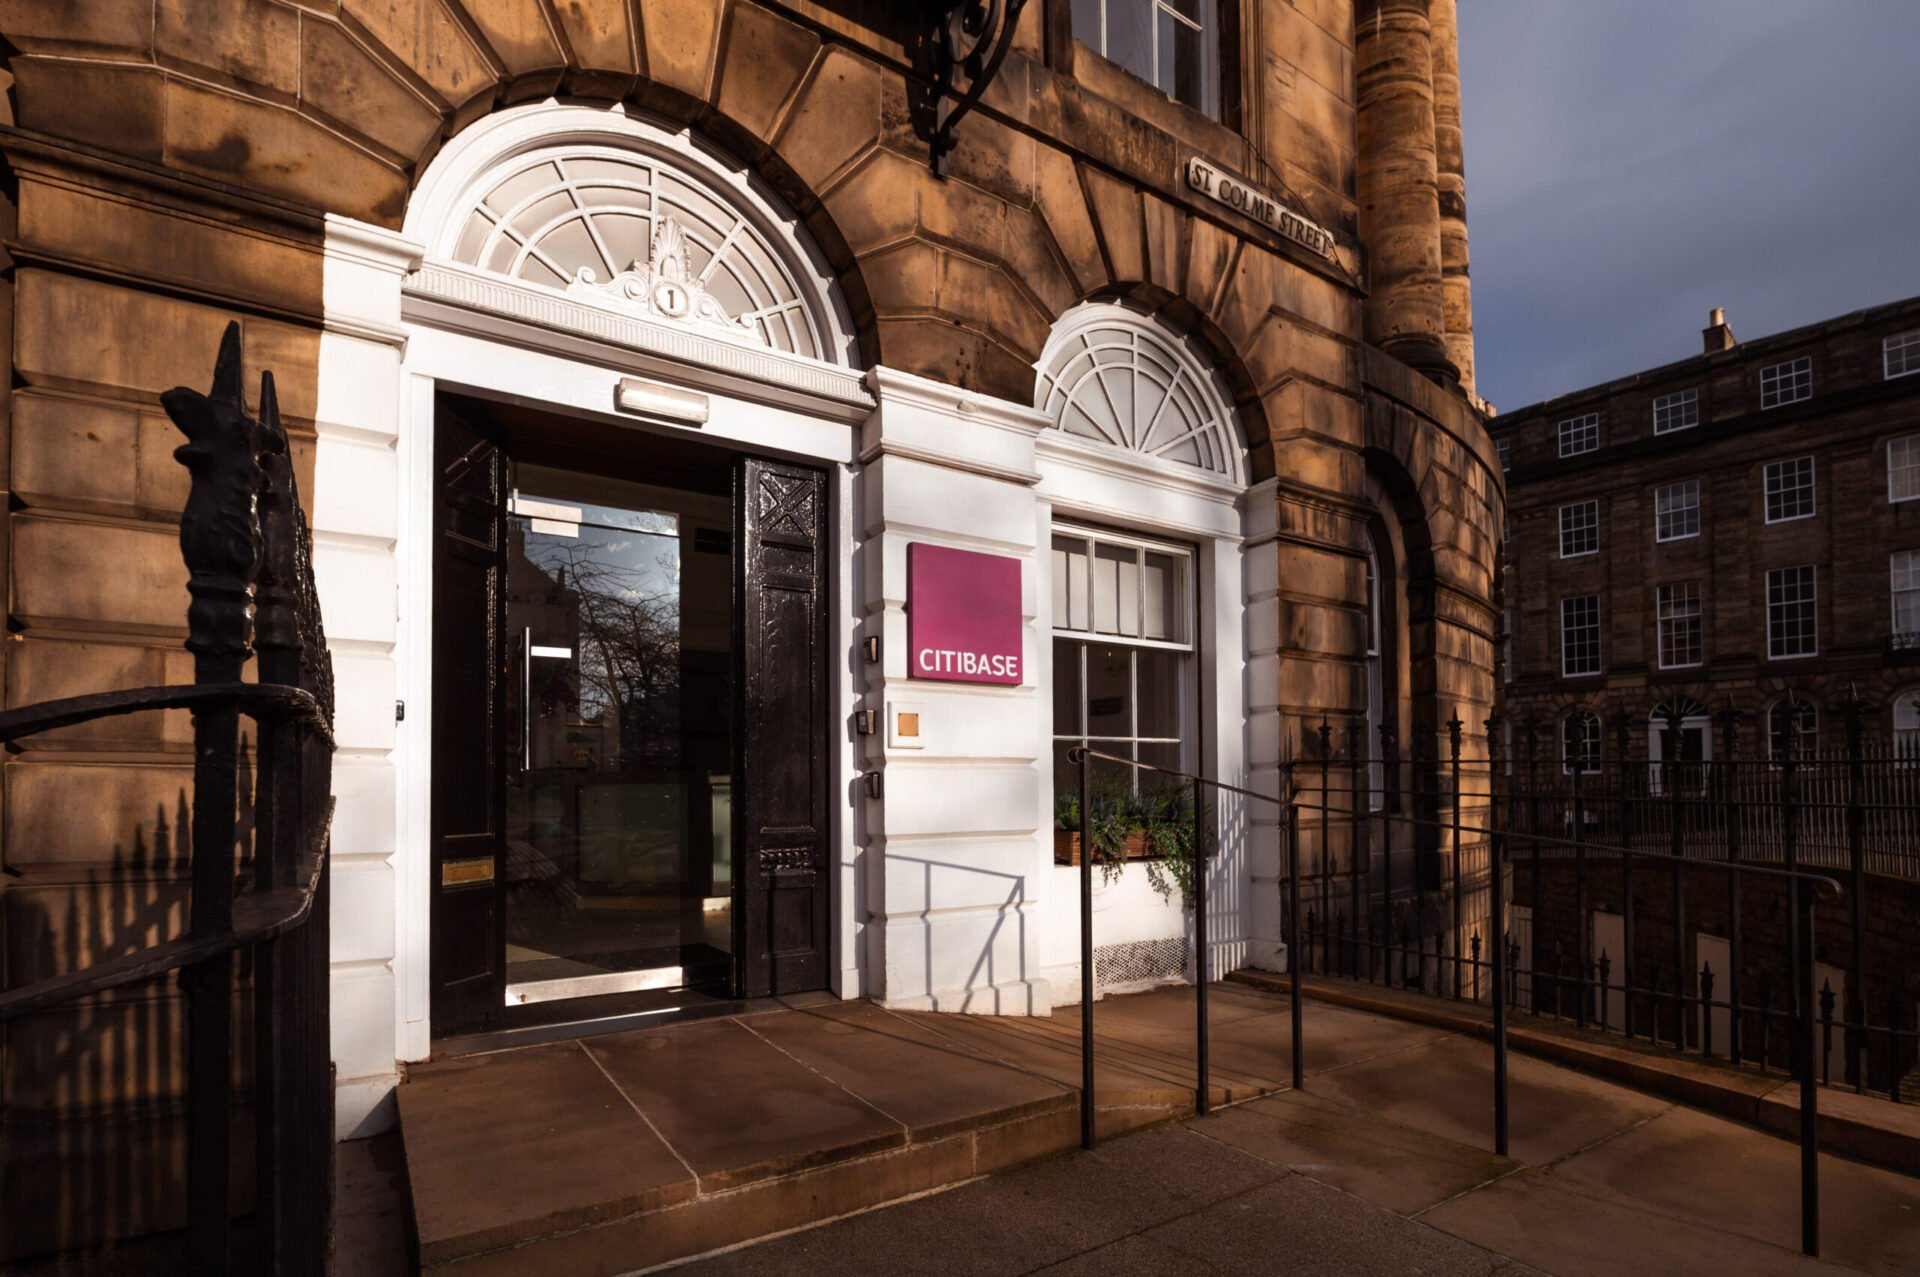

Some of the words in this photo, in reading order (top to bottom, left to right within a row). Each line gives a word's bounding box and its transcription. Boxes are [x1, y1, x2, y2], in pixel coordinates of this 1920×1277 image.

[1219, 179, 1274, 224] COLME
[1279, 211, 1332, 254] STREET
[667, 289, 674, 309] 1
[919, 648, 1018, 677] CITIBASE
